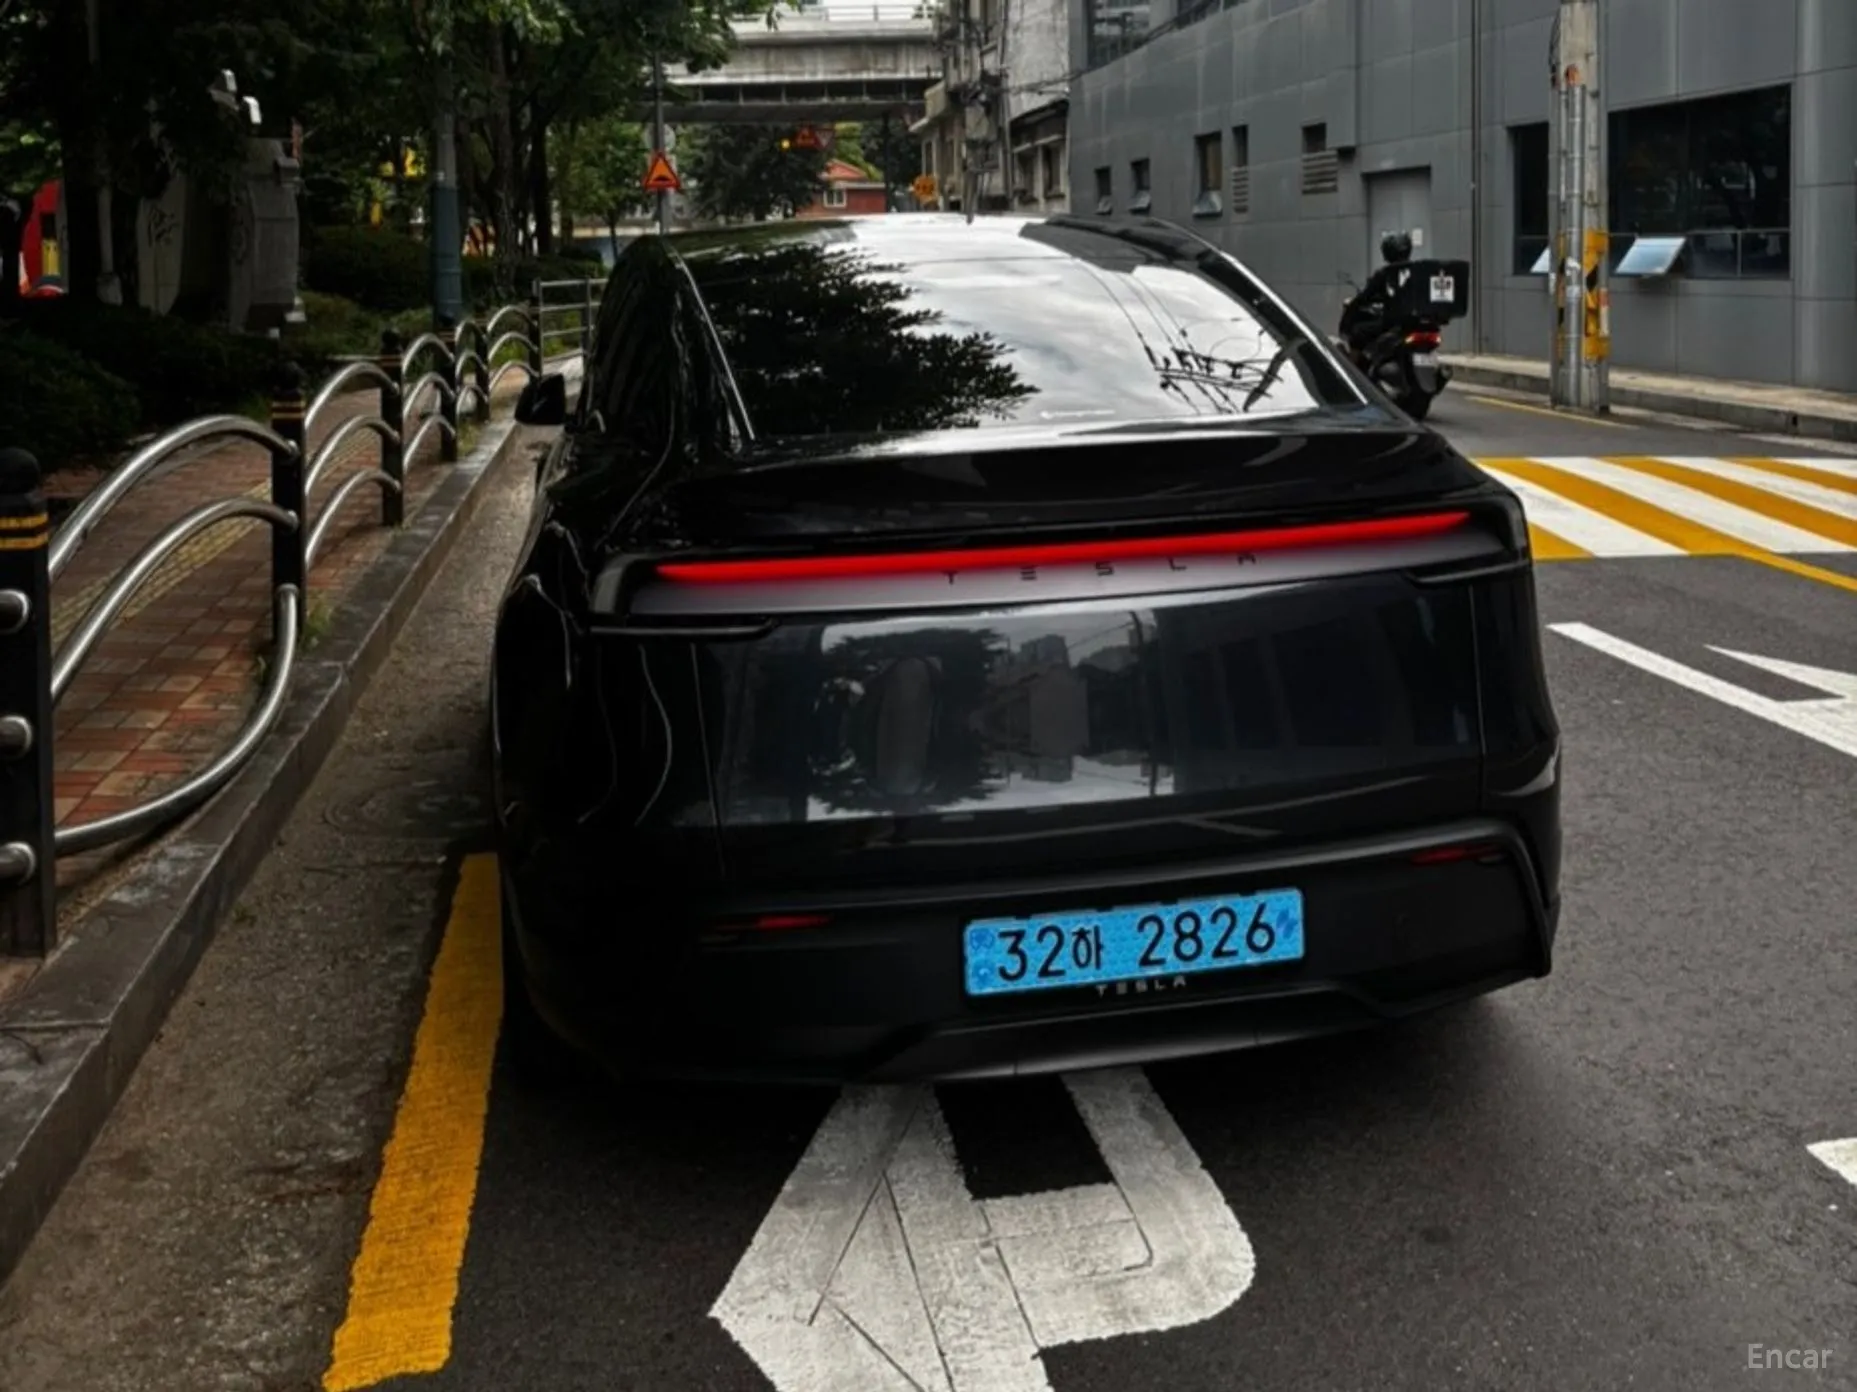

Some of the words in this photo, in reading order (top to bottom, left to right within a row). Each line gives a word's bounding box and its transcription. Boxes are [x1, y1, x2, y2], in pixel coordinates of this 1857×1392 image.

[943, 553, 1257, 585] TESLA
[999, 924, 1104, 982] 32하
[1136, 902, 1276, 968] 2826
